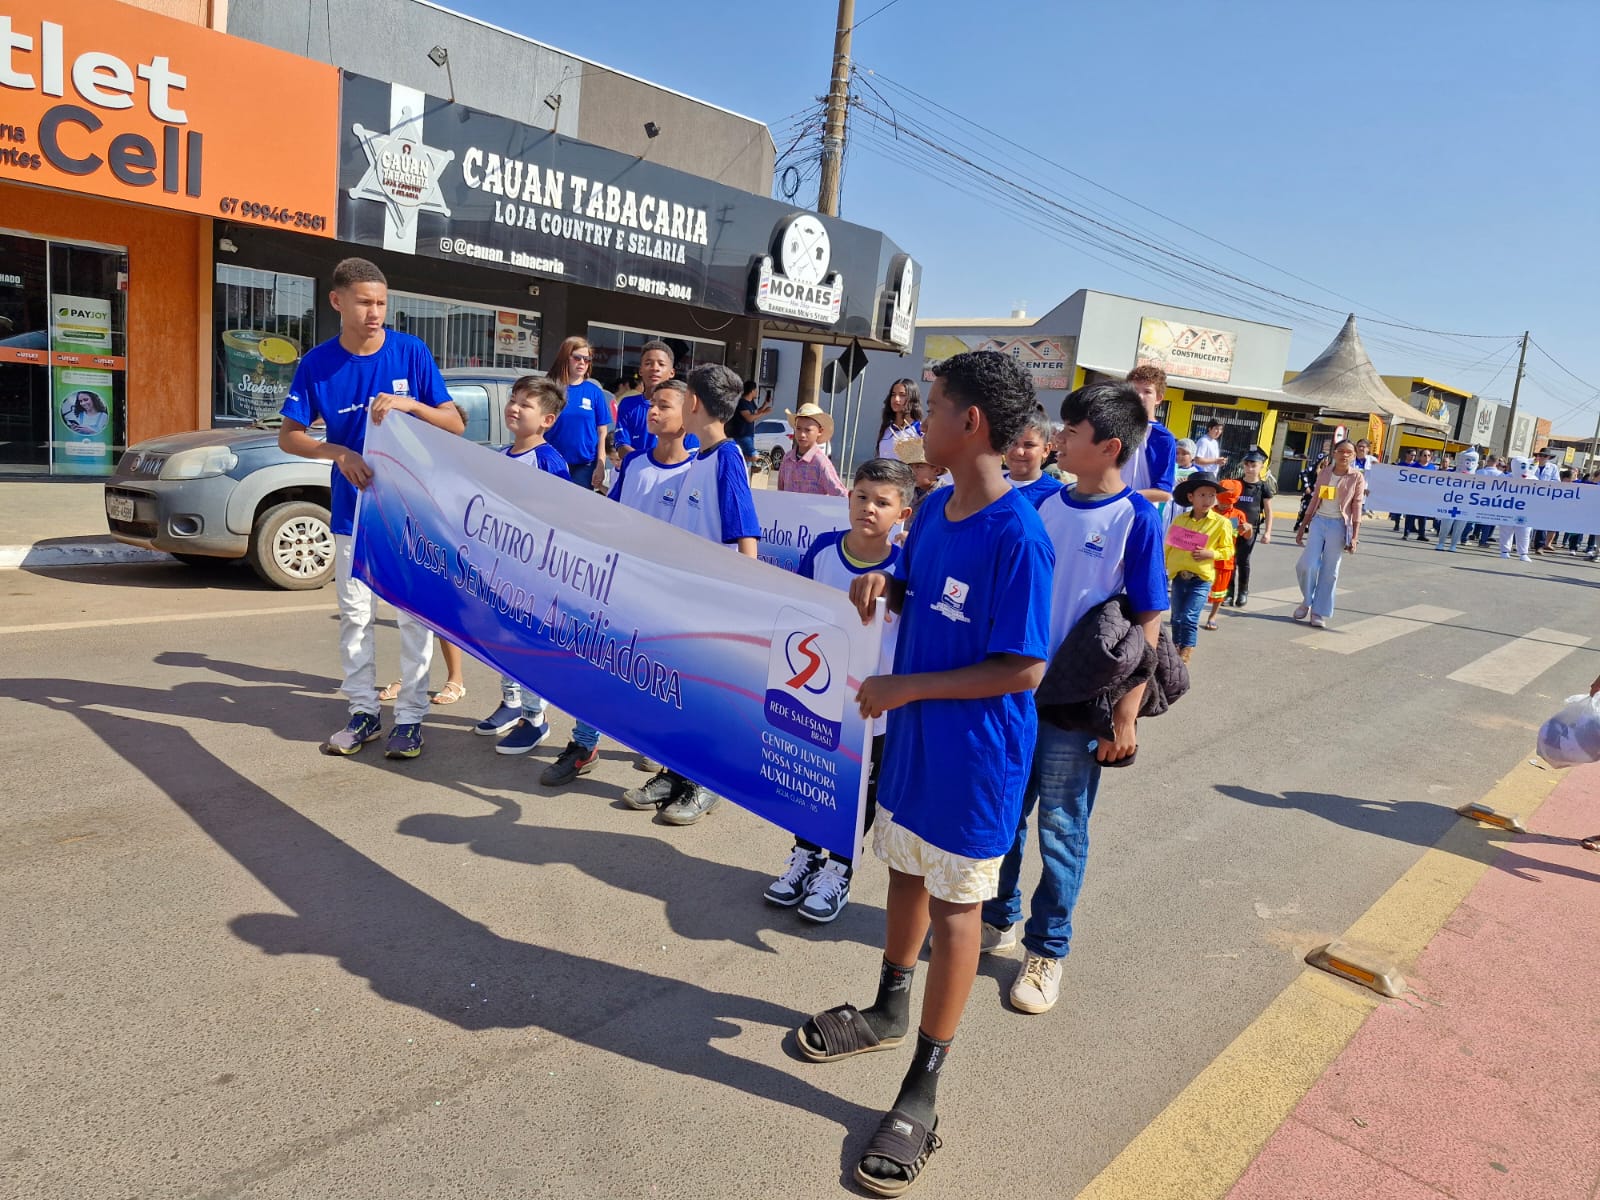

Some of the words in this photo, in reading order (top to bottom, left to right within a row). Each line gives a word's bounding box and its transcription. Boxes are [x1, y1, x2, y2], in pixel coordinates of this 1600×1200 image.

[38, 104, 203, 198] Cell
[381, 151, 428, 178] CAUAN
[463, 146, 565, 210] CAUAN
[570, 174, 708, 246] TABACARIA
[219, 197, 239, 214] 67
[241, 201, 327, 232] 99946-3581
[495, 200, 537, 231] LOJA
[541, 212, 612, 248] COUNTRY
[615, 229, 625, 251] E
[628, 232, 686, 265] SELARIA
[454, 239, 565, 275] @cauan_tabacaria
[770, 279, 832, 306] MORAES
[70, 308, 108, 320] PAYJOY
[1171, 348, 1229, 363] CONSTRUCENTER
[1398, 469, 1487, 490] Secretaria
[1491, 479, 1582, 500] Municipal
[1443, 490, 1464, 504] de
[1468, 492, 1526, 511] Saúde
[769, 700, 789, 719] REDE
[791, 710, 833, 738] SALESIANA
[761, 730, 799, 757] CENTRO
[800, 748, 838, 776] JUVENIL
[811, 731, 832, 748] BRASIL
[761, 747, 791, 770] NOSSA
[793, 761, 836, 791] SENHORA
[759, 763, 837, 811] AUXILIADORA
